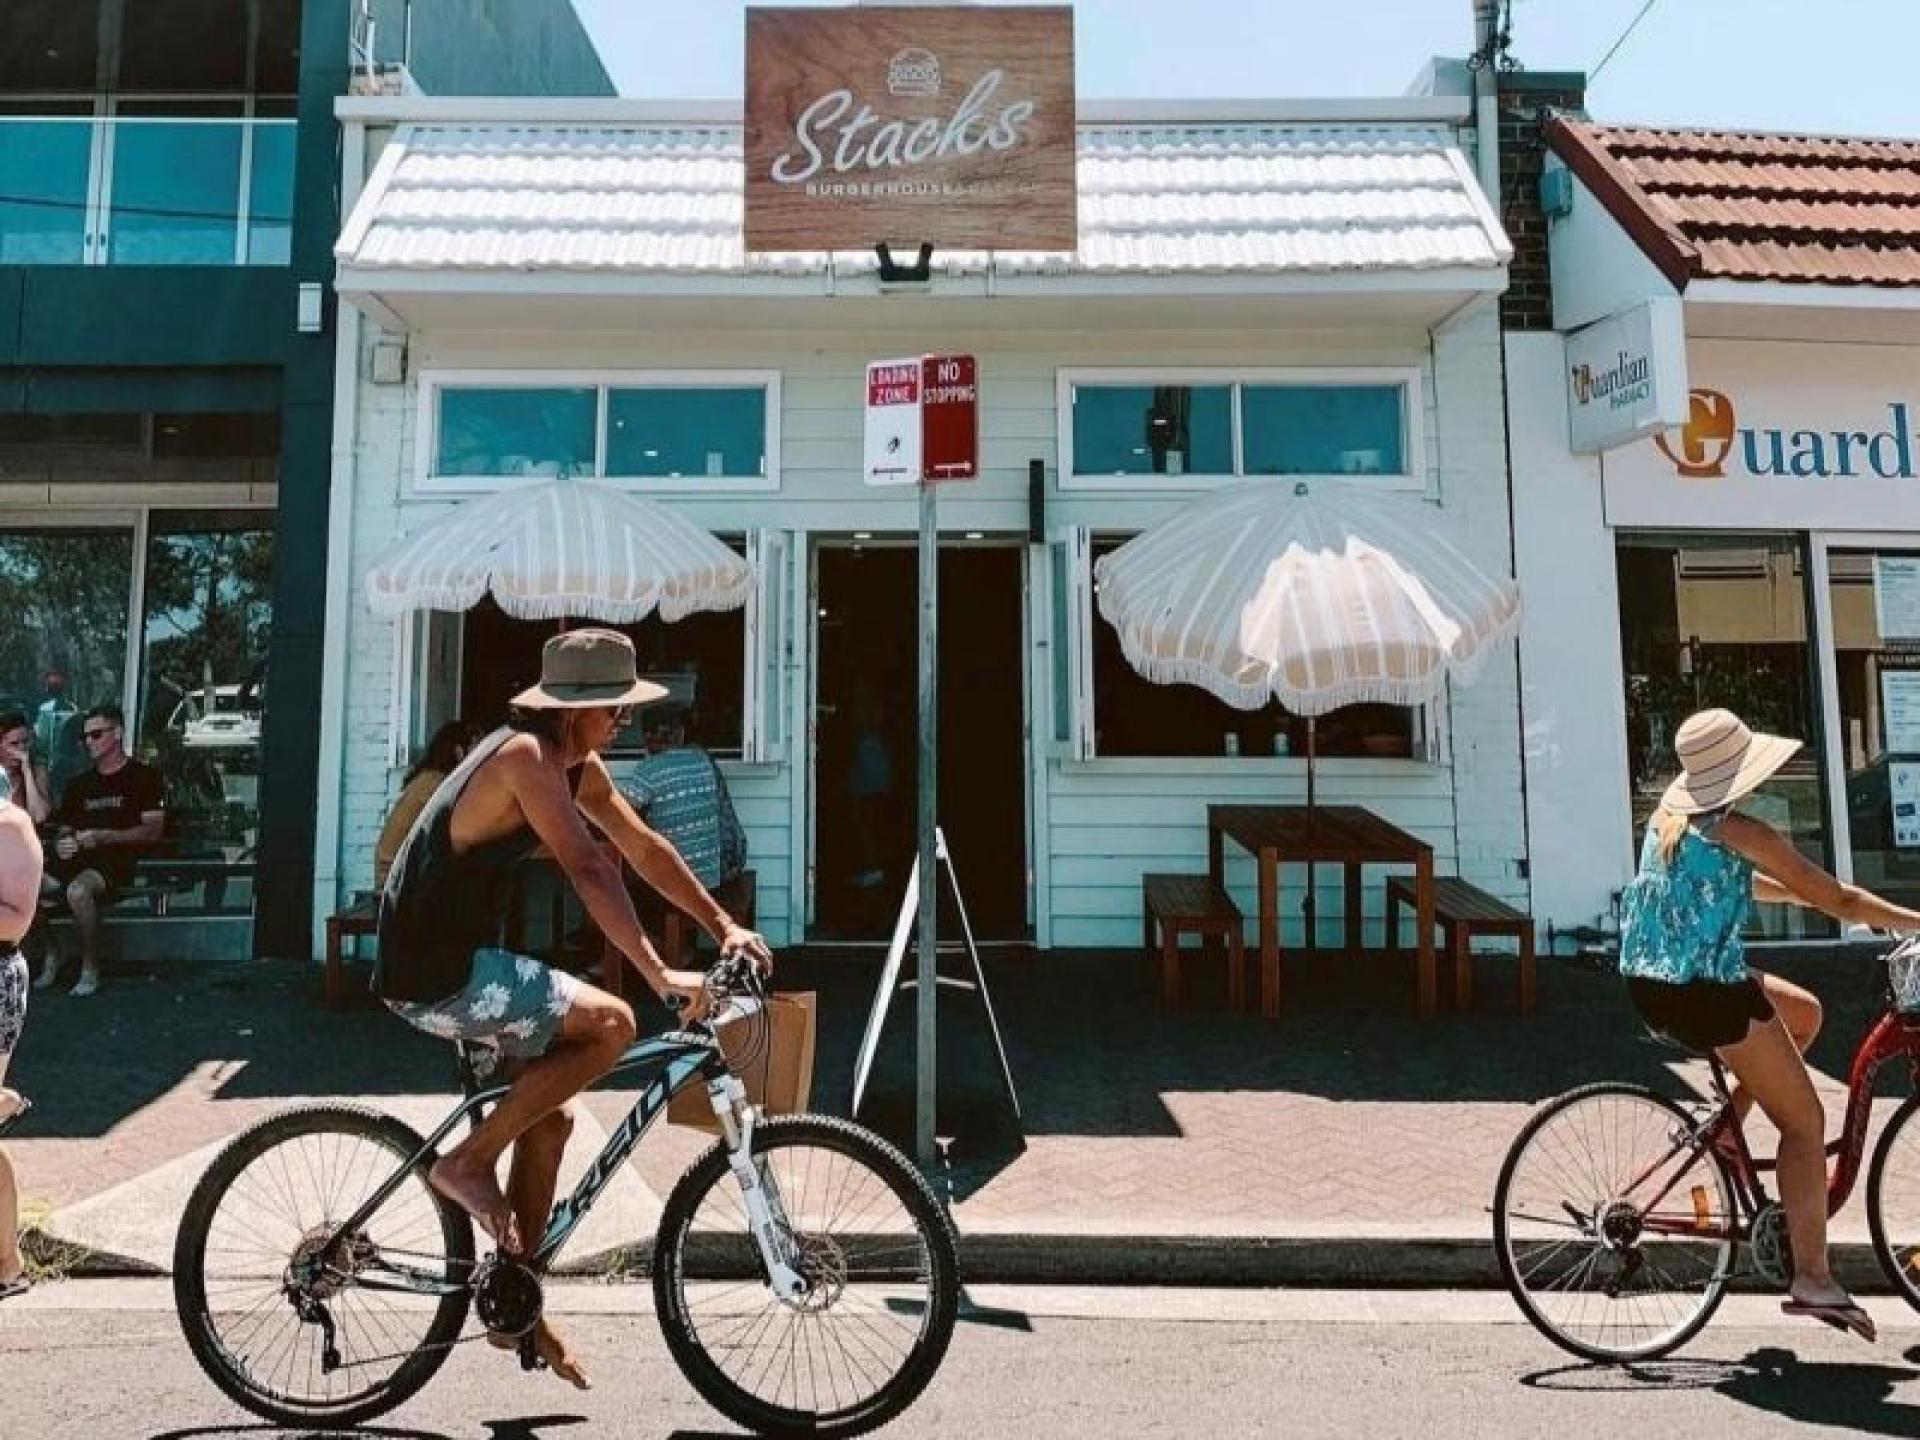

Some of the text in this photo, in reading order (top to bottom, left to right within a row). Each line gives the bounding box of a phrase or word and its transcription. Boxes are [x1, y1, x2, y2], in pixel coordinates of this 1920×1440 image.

[770, 69, 1033, 183] Stacks
[875, 386, 911, 404] ZONE
[922, 385, 976, 404] STOPPING
[938, 362, 960, 382] NO
[1572, 350, 1648, 405] Guardian
[1653, 387, 1920, 478] Guard
[570, 1064, 670, 1221] REID
